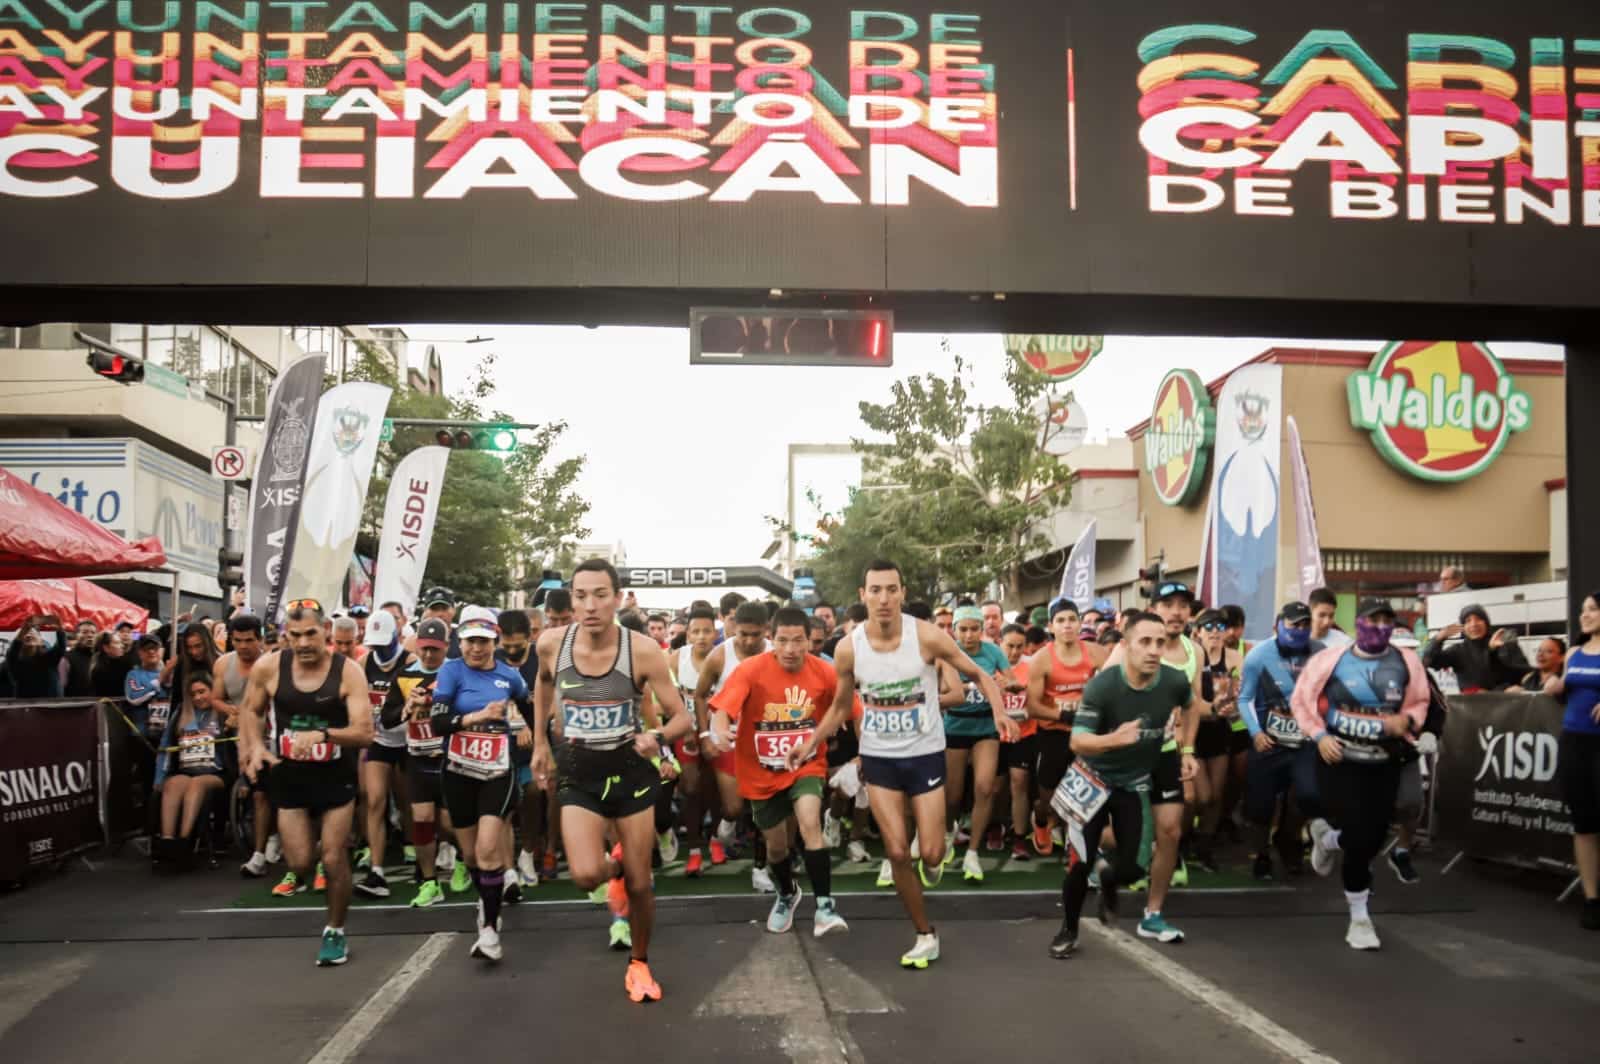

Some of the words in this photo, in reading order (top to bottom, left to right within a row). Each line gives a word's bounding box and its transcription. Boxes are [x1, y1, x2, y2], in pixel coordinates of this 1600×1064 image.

[850, 10, 982, 44] DE
[0, 85, 814, 127] AYUNTAMIENTO
[847, 94, 987, 131] DE
[1138, 106, 1600, 180] CAPI
[0, 133, 998, 208] CULIACÁN
[1148, 174, 1295, 217] DE
[1354, 372, 1530, 431] Waldo's
[630, 569, 726, 585] SALIDA
[566, 706, 623, 730] 2987
[866, 710, 914, 732] 2986
[1271, 716, 1299, 733] 210
[460, 738, 493, 760] 148
